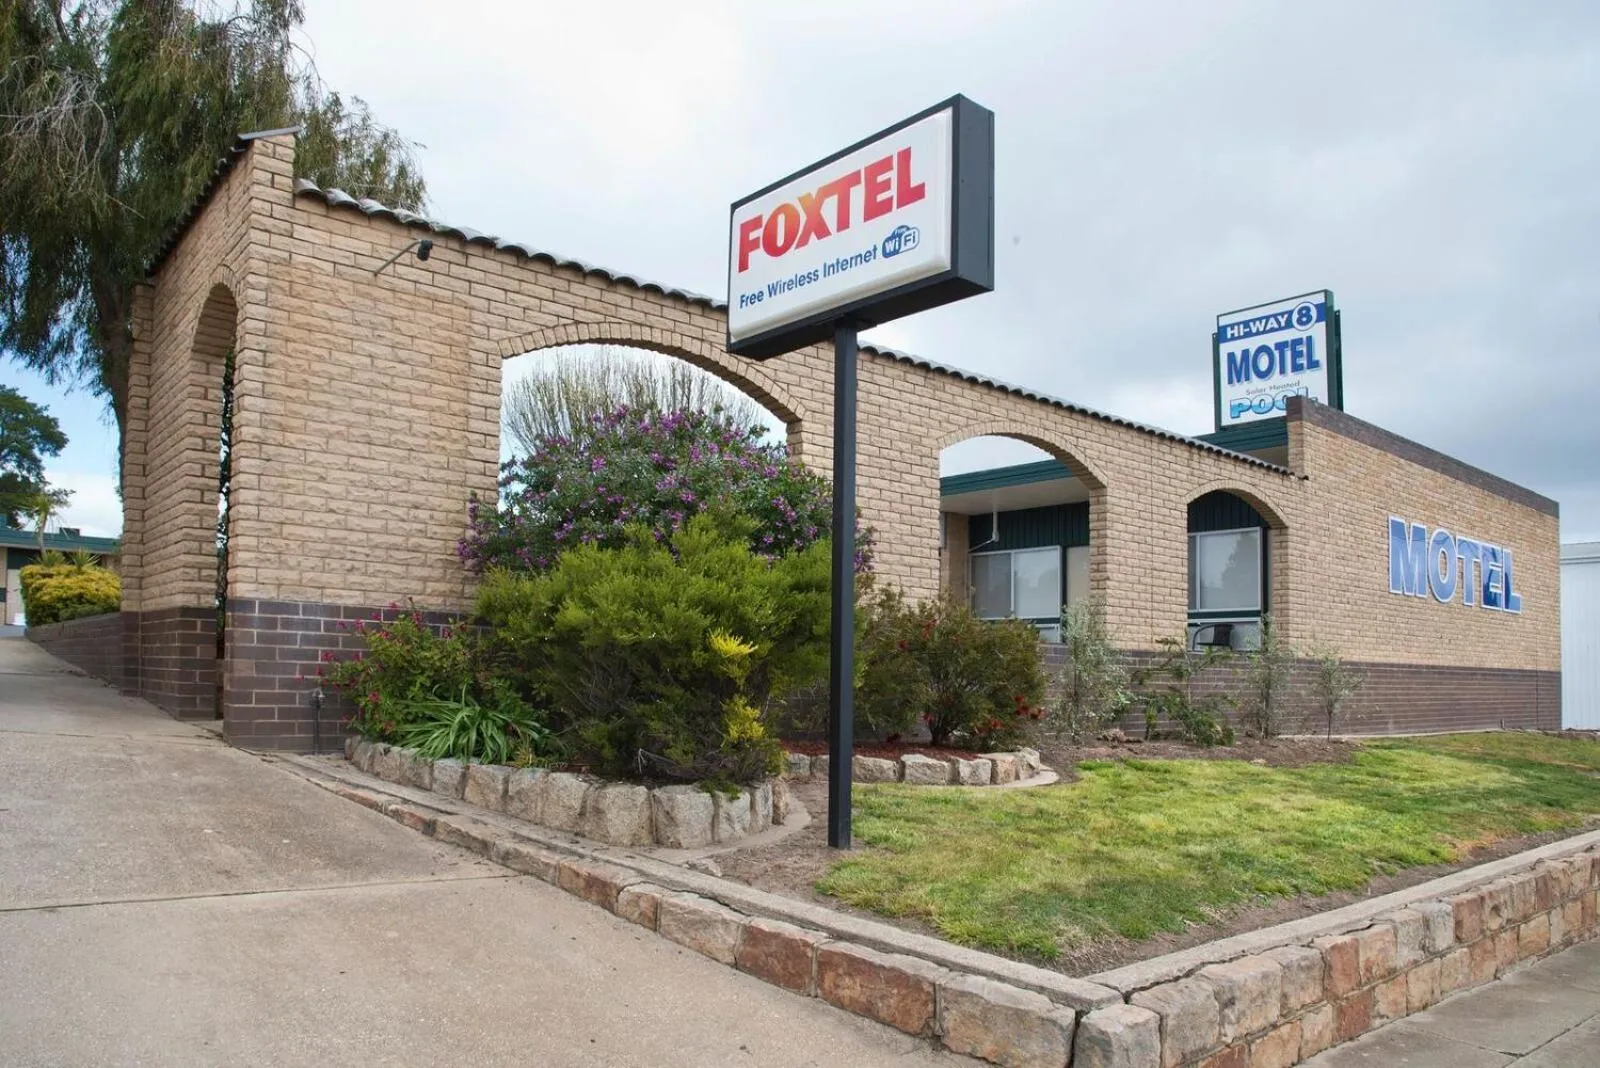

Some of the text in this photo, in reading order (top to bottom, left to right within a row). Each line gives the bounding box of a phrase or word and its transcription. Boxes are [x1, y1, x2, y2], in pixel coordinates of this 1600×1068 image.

[738, 147, 926, 273] FOXTEL
[739, 290, 764, 309] Free
[768, 269, 819, 298] Wireless
[823, 245, 877, 278] Internet
[1227, 305, 1313, 339] HI-WAY 8
[1227, 335, 1320, 385] MOTEL
[1389, 515, 1523, 614] MOTEL
